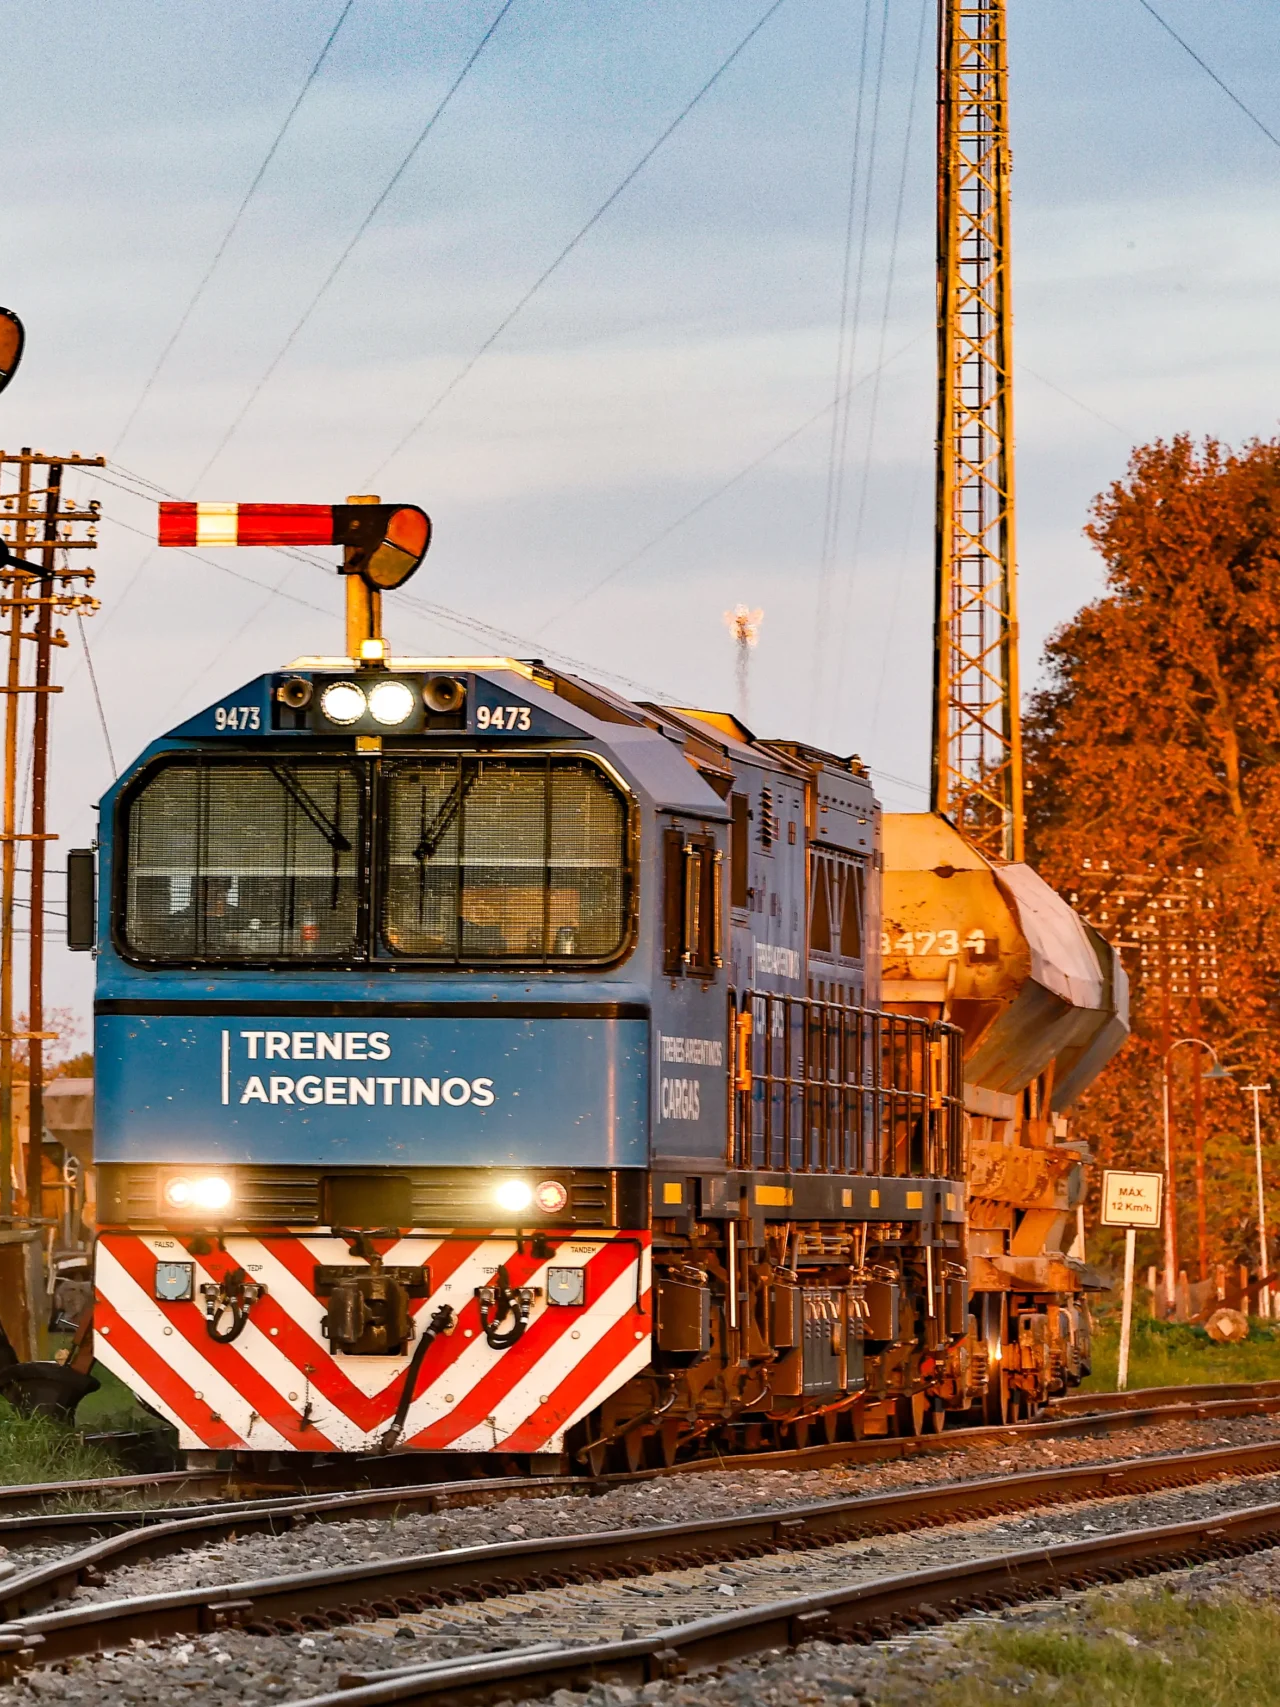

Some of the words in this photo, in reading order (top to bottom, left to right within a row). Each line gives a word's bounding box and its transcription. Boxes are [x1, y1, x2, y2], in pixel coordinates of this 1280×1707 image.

[215, 707, 260, 730] 9473
[476, 706, 531, 730] 9473
[240, 1031, 391, 1060] TRENES
[240, 1075, 495, 1106] ARGENTINOS
[662, 1078, 700, 1120] CARGAS
[1112, 1202, 1123, 1210] 12
[570, 1246, 596, 1254] TANDEM
